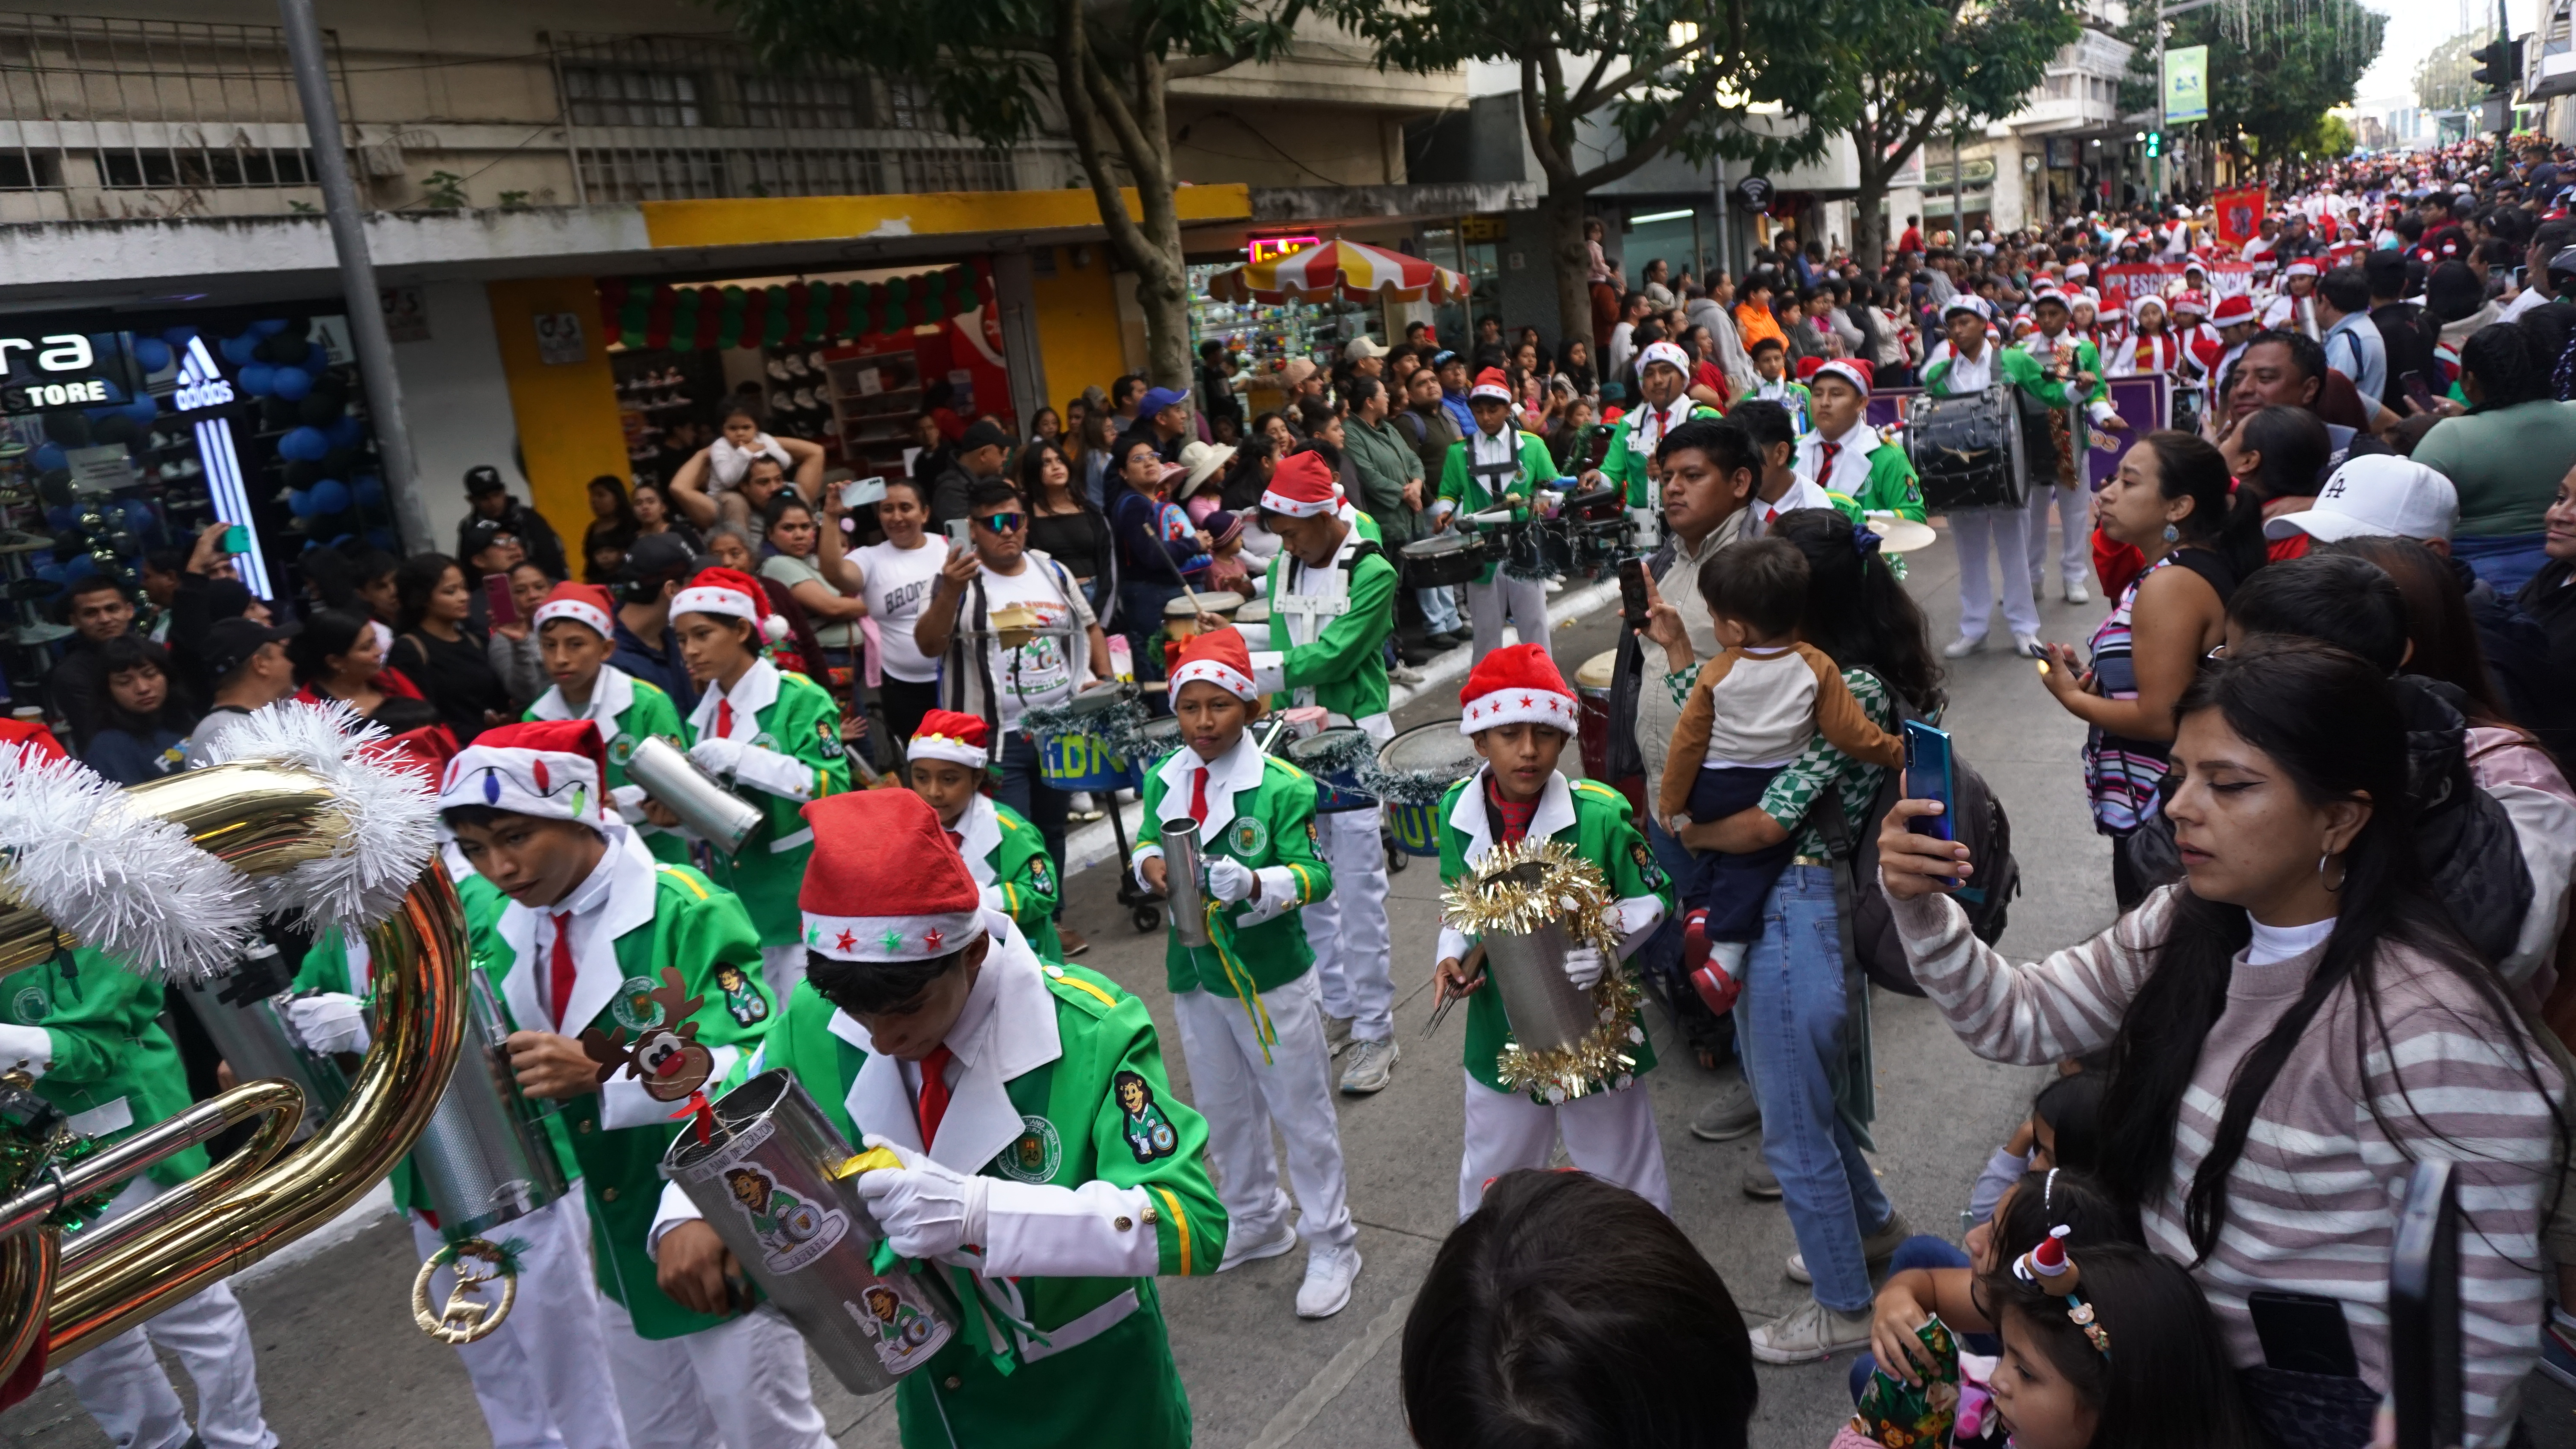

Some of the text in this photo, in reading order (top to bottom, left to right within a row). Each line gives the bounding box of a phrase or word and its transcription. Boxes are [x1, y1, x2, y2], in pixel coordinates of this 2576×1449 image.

[3, 380, 108, 408] STORE
[176, 378, 234, 411] adidas
[884, 580, 927, 615] BROO
[708, 1155, 730, 1173] BAND
[730, 1147, 742, 1159] DE
[741, 1122, 774, 1151] CORAZON
